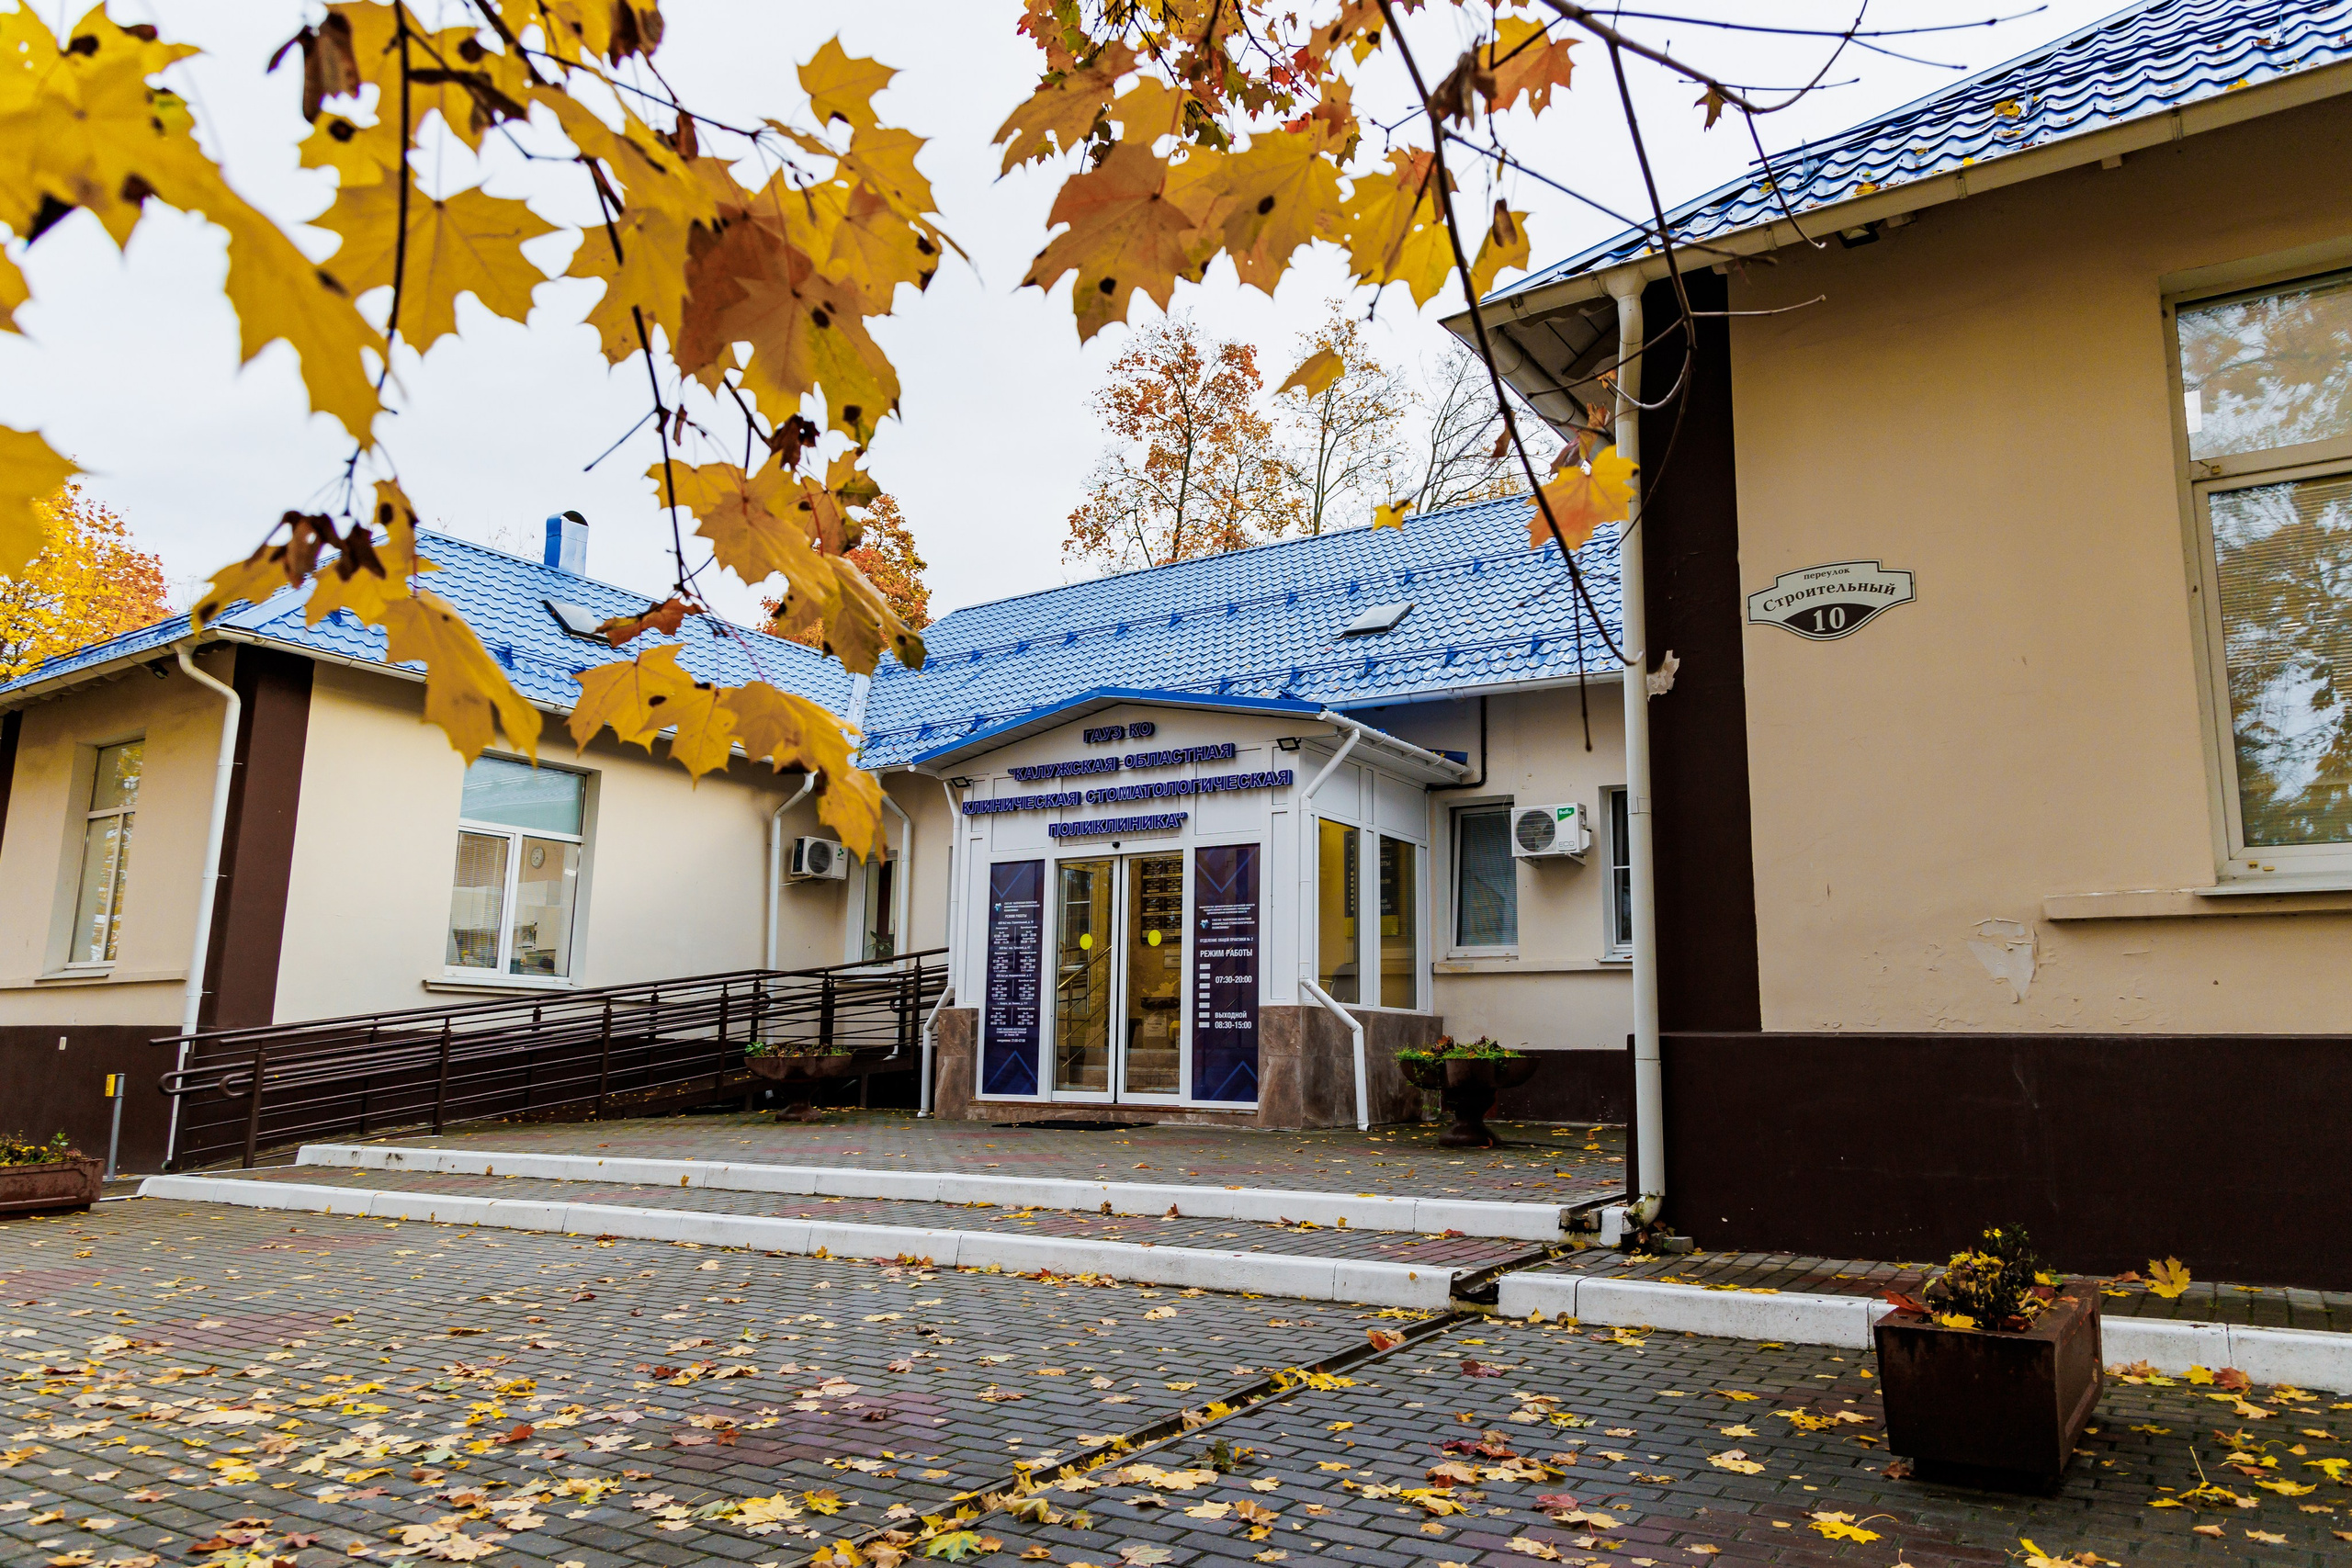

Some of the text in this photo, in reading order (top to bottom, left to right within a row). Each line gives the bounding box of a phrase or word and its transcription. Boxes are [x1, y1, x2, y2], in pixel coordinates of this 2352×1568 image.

[1804, 567, 1850, 581] переулок
[1763, 582, 1896, 613] Строительный
[1814, 606, 1846, 632] 10
[1083, 722, 1155, 743] ГАУЗ КО
[1124, 742, 1236, 769] ОБЛАСТНАЯ
[962, 770, 1294, 815] КЛИНИЧЕСКАЯ СТОМАТОЛОГИЧЕСКАЯ
[1200, 949, 1253, 958] РЕЖИМ РАБОТЫ
[1215, 976, 1252, 984] 07:30-20:00
[1215, 1021, 1252, 1030] 08:30-15:00
